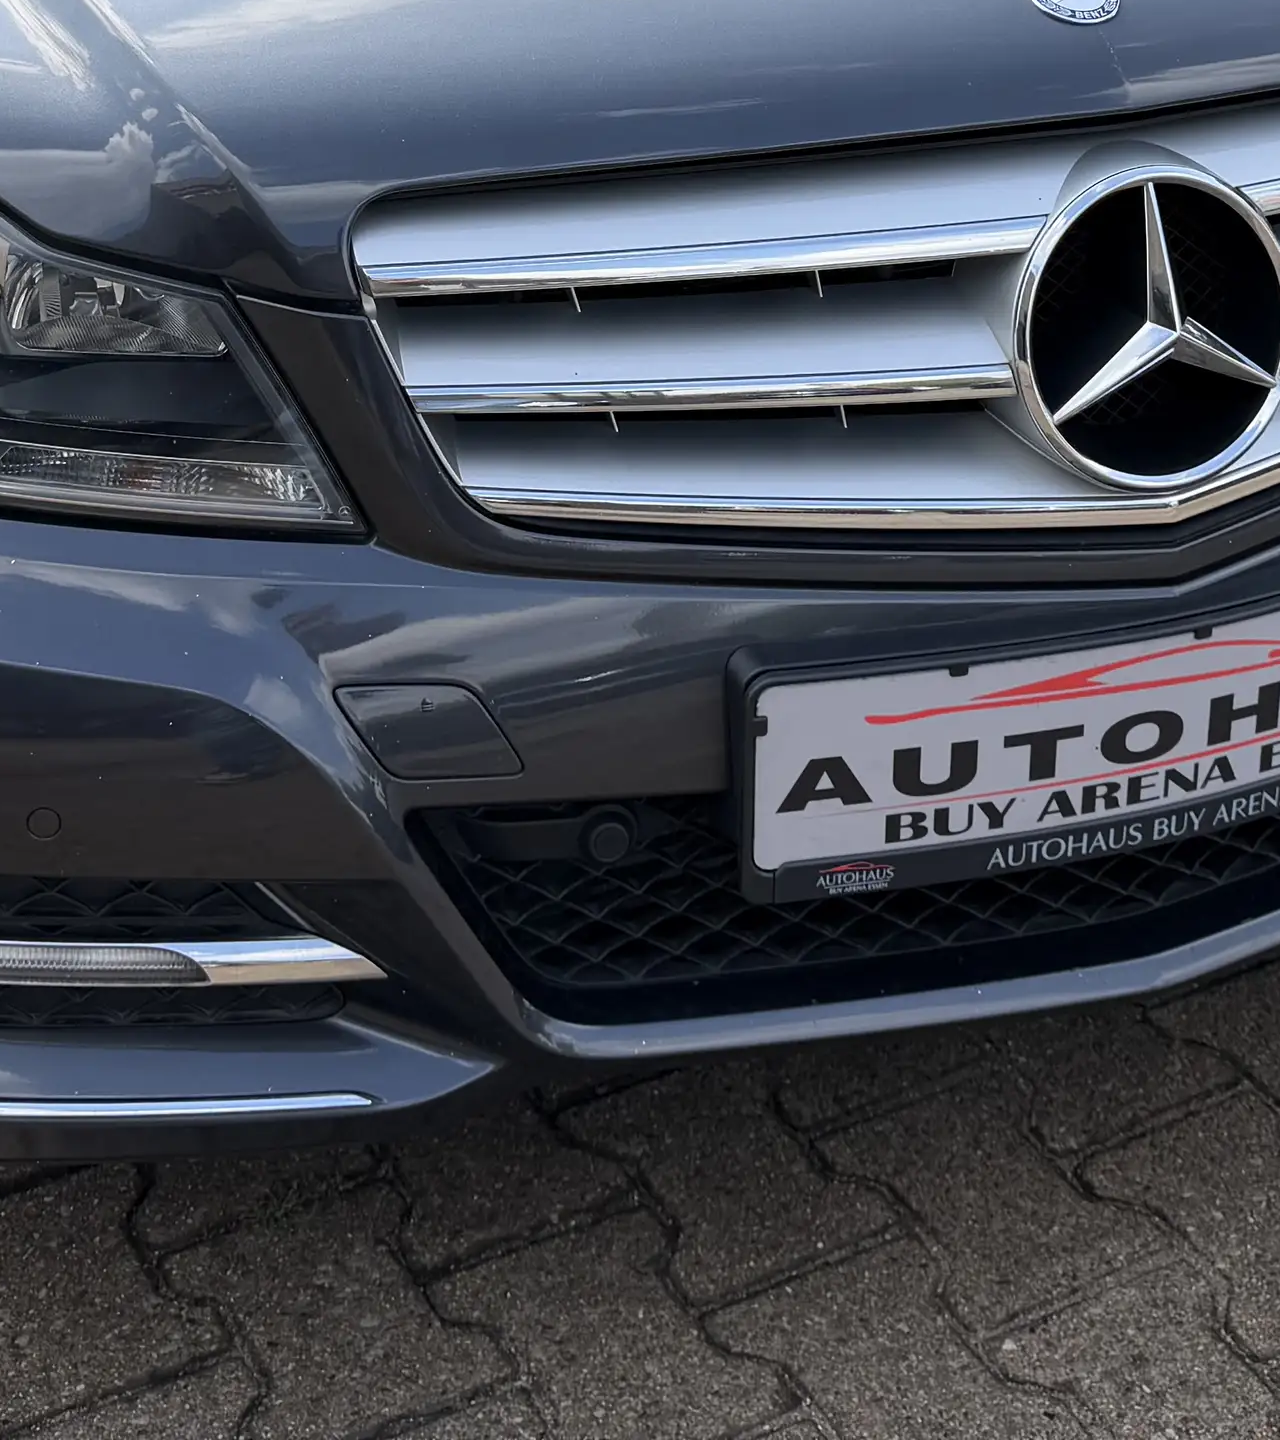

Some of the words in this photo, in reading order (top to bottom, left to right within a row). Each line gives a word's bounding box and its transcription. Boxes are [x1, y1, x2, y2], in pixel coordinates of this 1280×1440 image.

[1075, 9, 1108, 19] BENZ
[884, 797, 1017, 844] BUY
[1036, 755, 1237, 823] ARENA
[986, 823, 1143, 870] AUTOHAUS
[1152, 808, 1207, 841] BUY
[816, 867, 894, 888] AUTOHAUS
